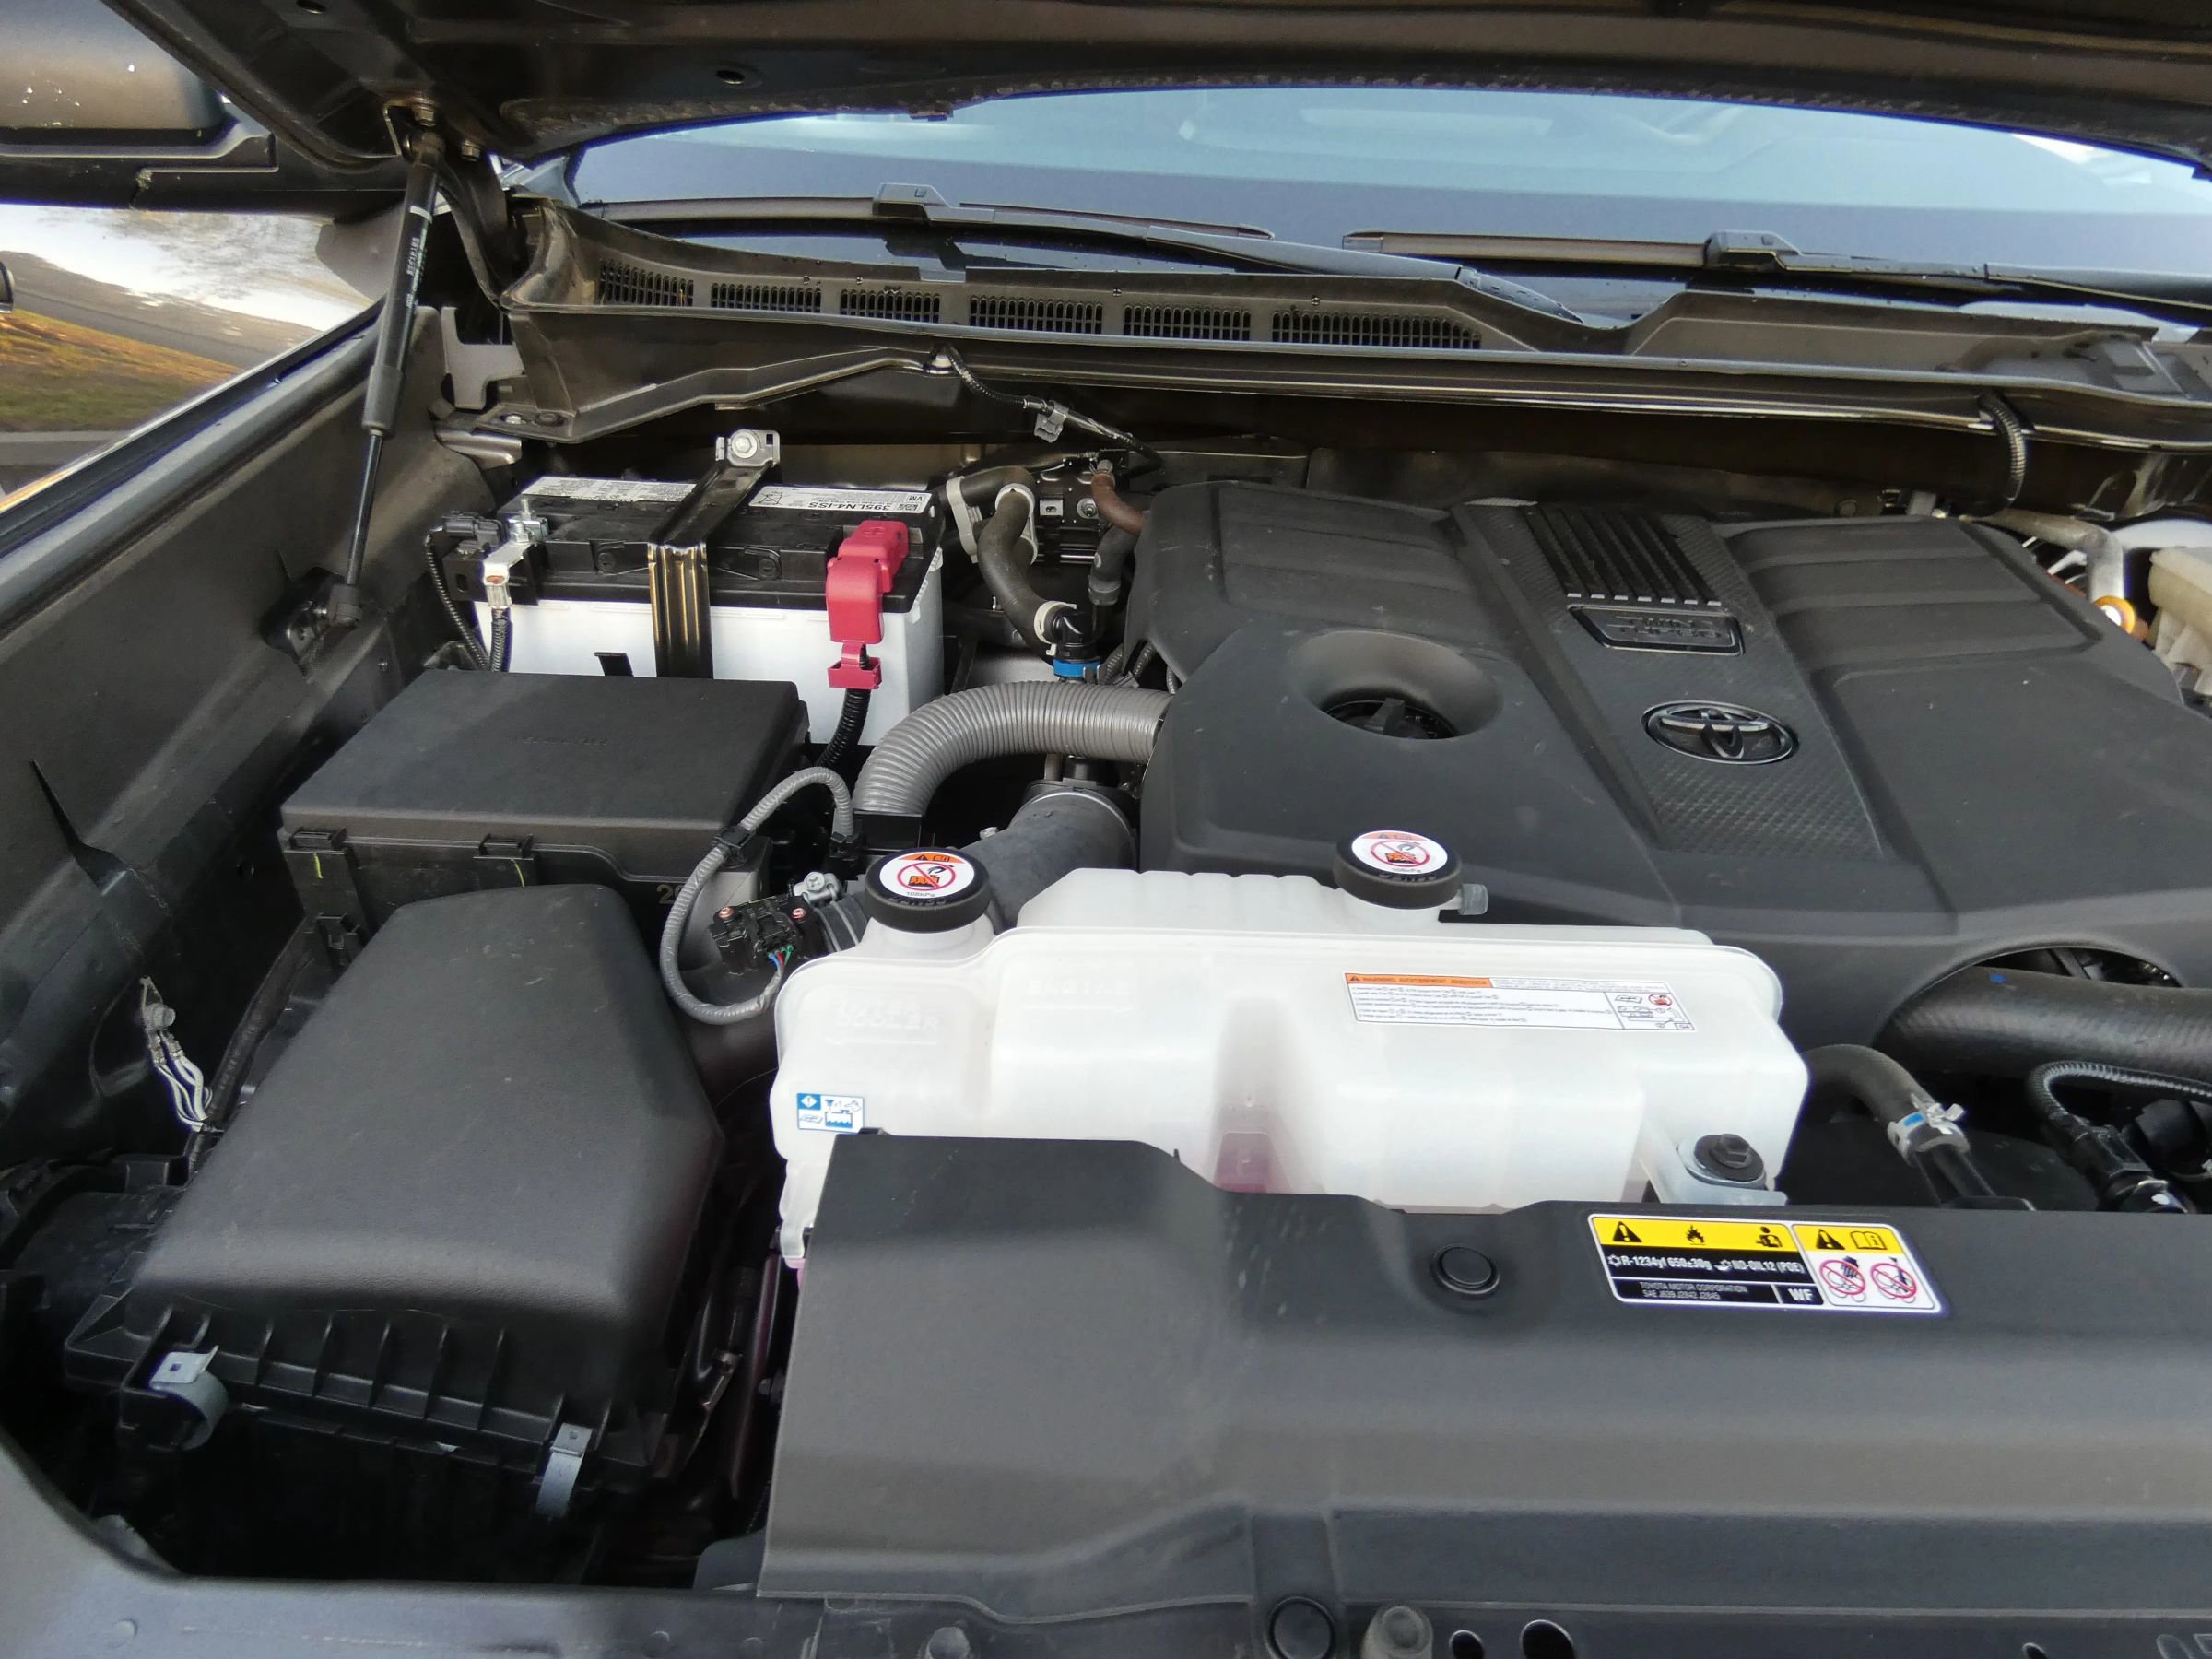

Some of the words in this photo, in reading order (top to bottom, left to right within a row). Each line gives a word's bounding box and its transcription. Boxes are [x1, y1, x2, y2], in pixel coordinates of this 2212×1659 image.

[1639, 1281, 1668, 1290] TOYOTA
[1668, 1282, 1696, 1291] MOTOR
[1696, 1283, 1748, 1293] CORPORATION
[1788, 1288, 1814, 1301] WF
